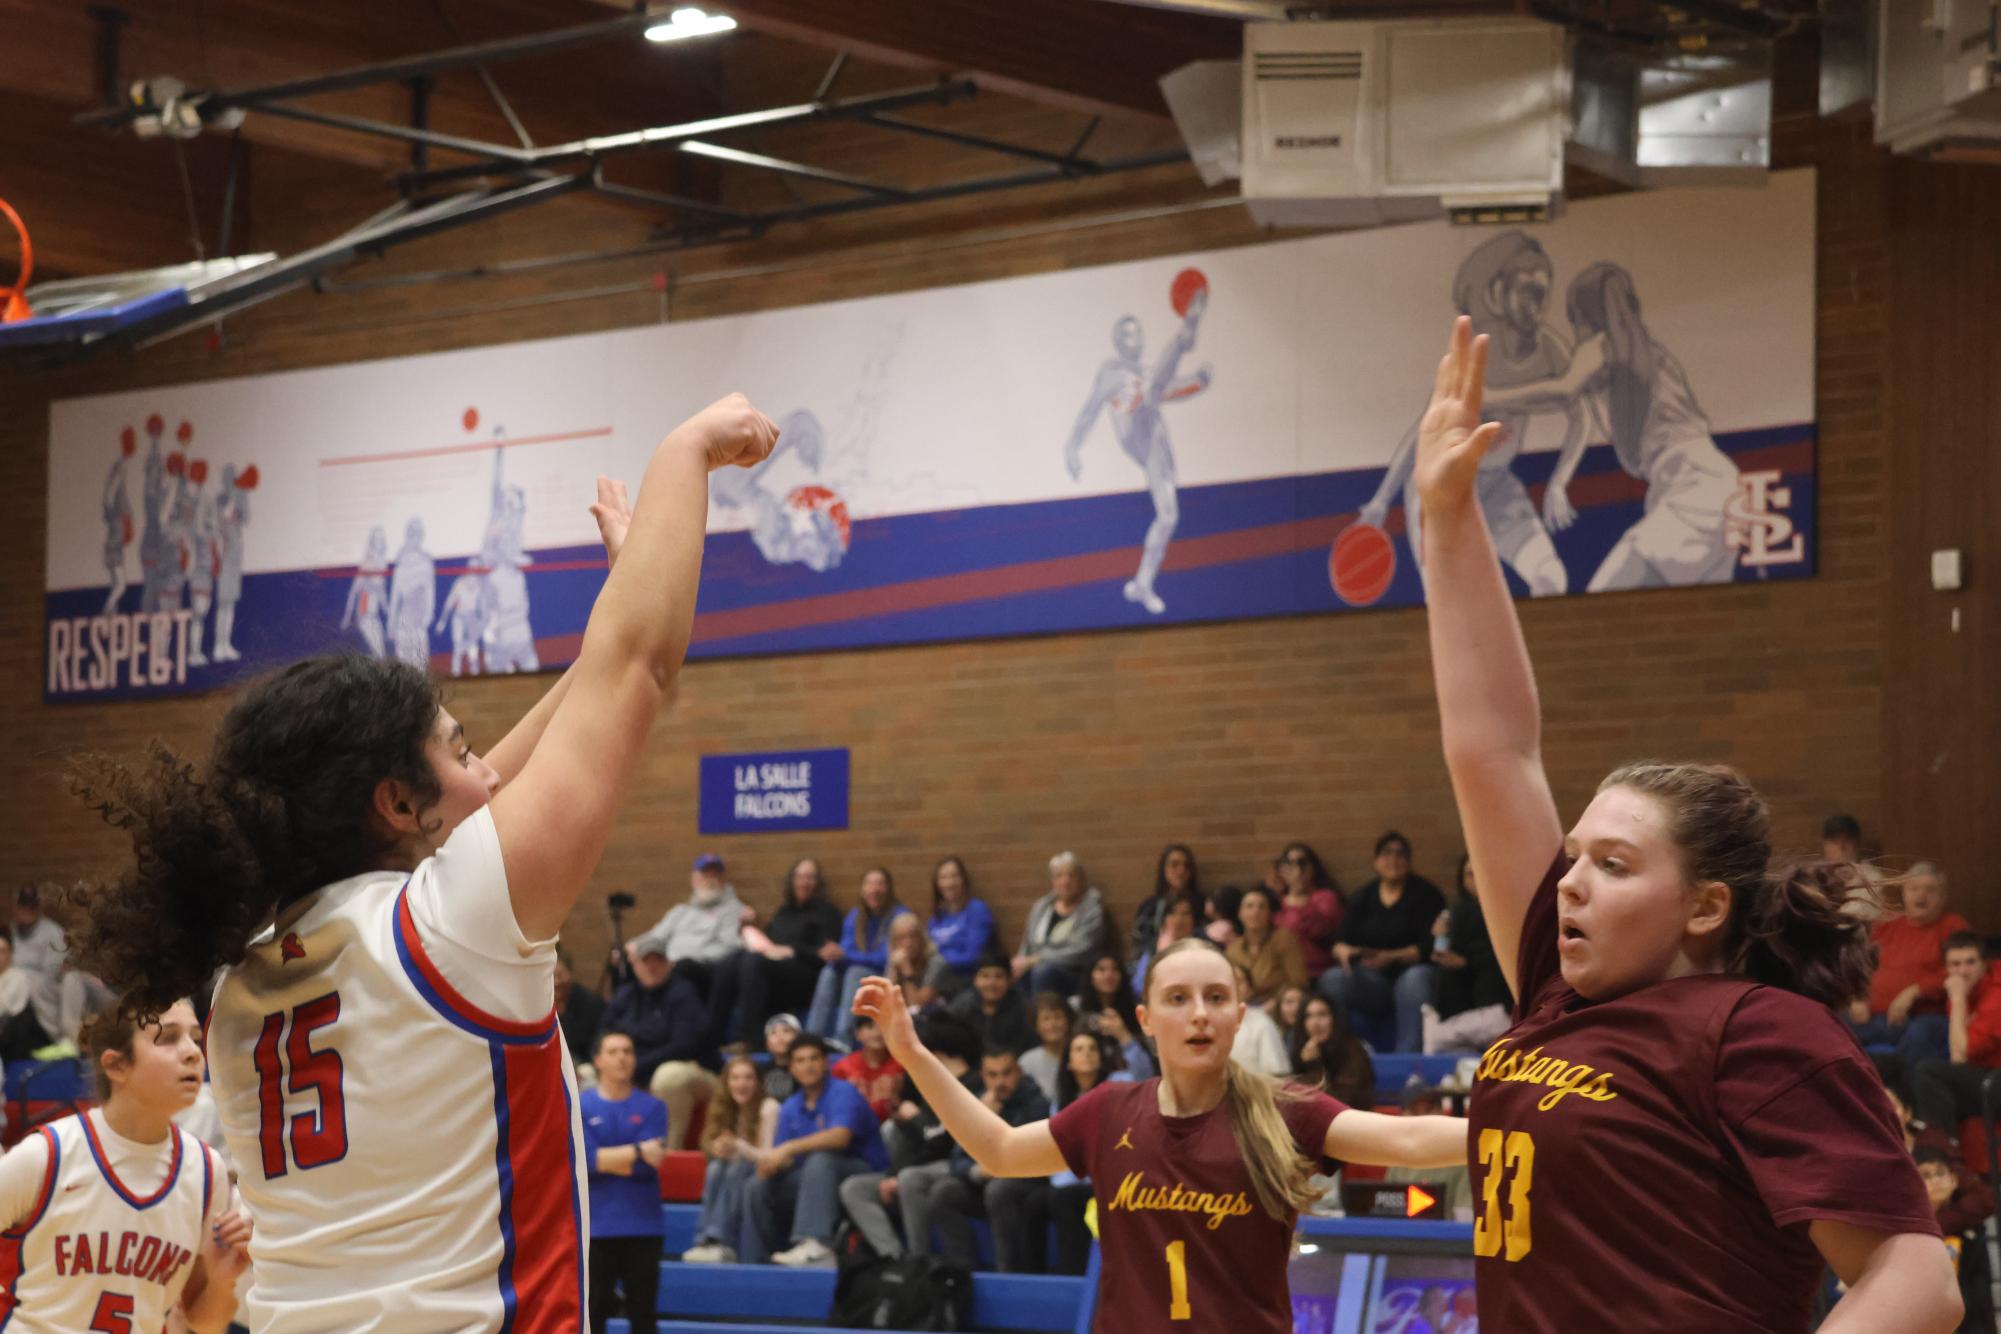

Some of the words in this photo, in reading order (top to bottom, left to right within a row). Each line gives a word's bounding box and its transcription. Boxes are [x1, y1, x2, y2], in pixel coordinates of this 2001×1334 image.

[48, 608, 194, 693] RESPECT
[734, 764, 759, 791] LA
[760, 761, 812, 789] SALLE
[734, 790, 811, 819] FALCONS
[253, 990, 349, 1181] 15
[1108, 1170, 1253, 1230] Mustangs
[1473, 1128, 1536, 1263] 33
[1165, 1240, 1191, 1320] 1
